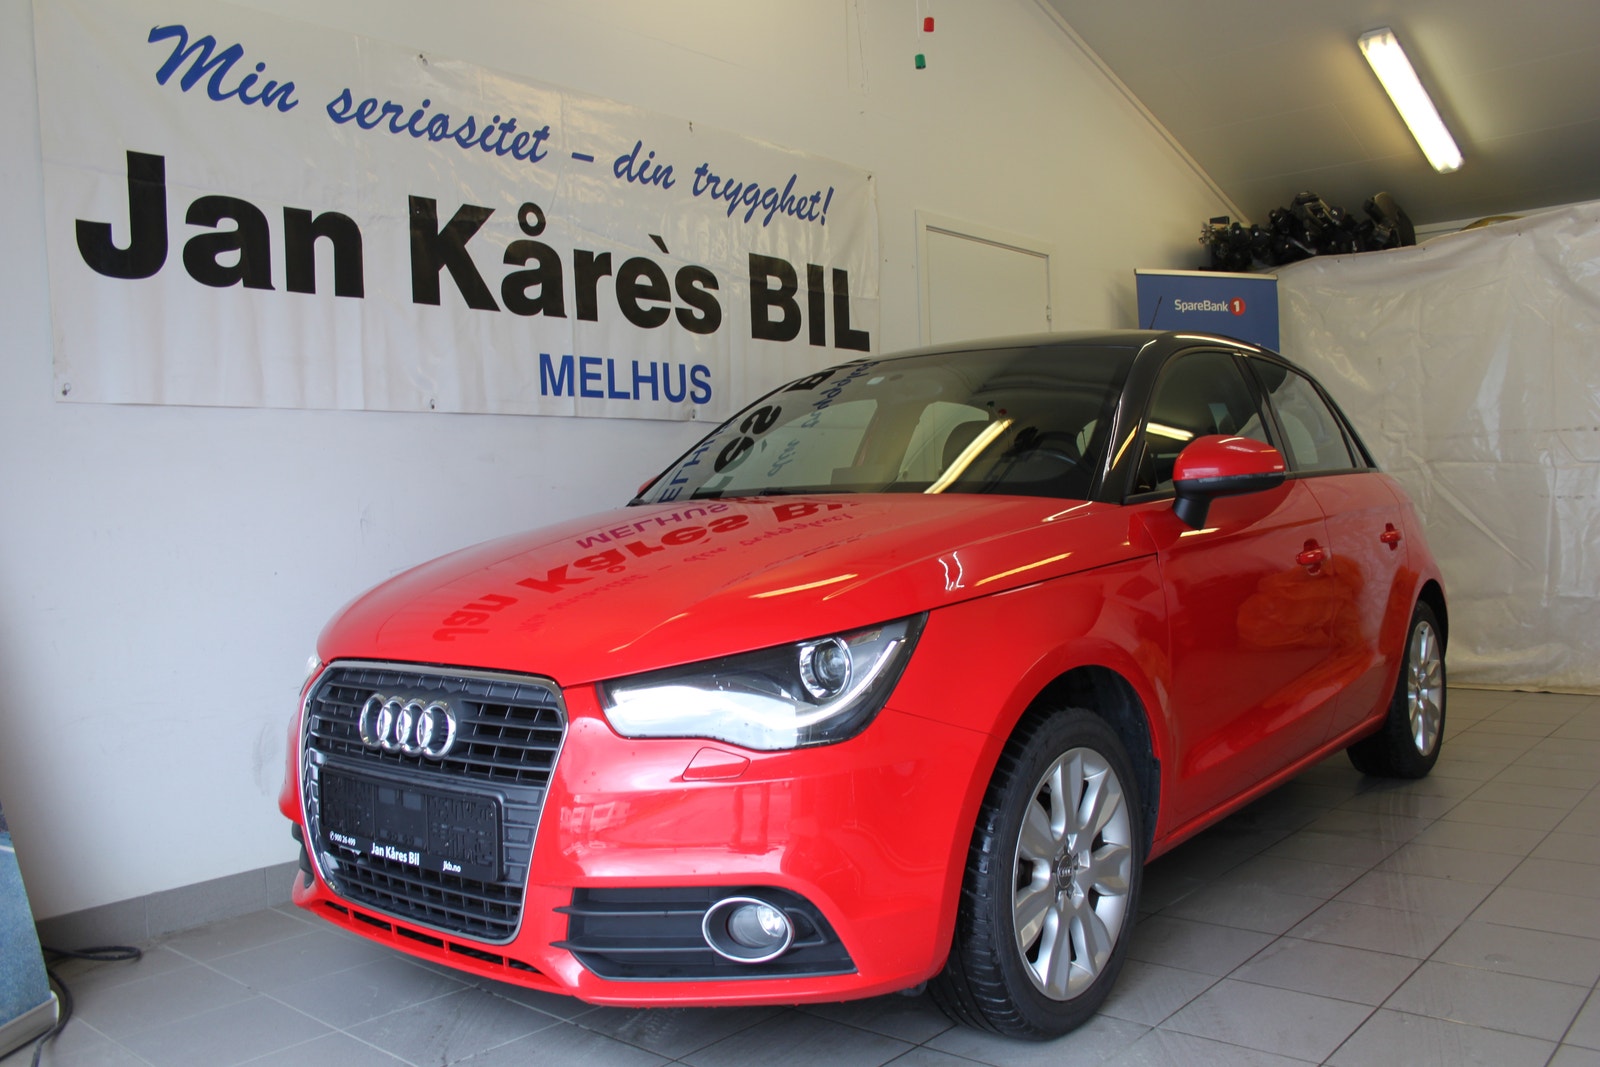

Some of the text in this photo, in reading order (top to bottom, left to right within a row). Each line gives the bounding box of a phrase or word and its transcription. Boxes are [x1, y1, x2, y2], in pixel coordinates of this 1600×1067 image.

[148, 26, 299, 112] Min
[326, 88, 550, 163] seriøsitet
[613, 139, 675, 189] din
[692, 162, 834, 227] trygghet!
[75, 150, 870, 352] Jan Kårès BIL
[1174, 298, 1229, 313] SpareBank
[539, 353, 713, 404] MELHUS
[371, 842, 420, 866] Jan Kåres Bil
